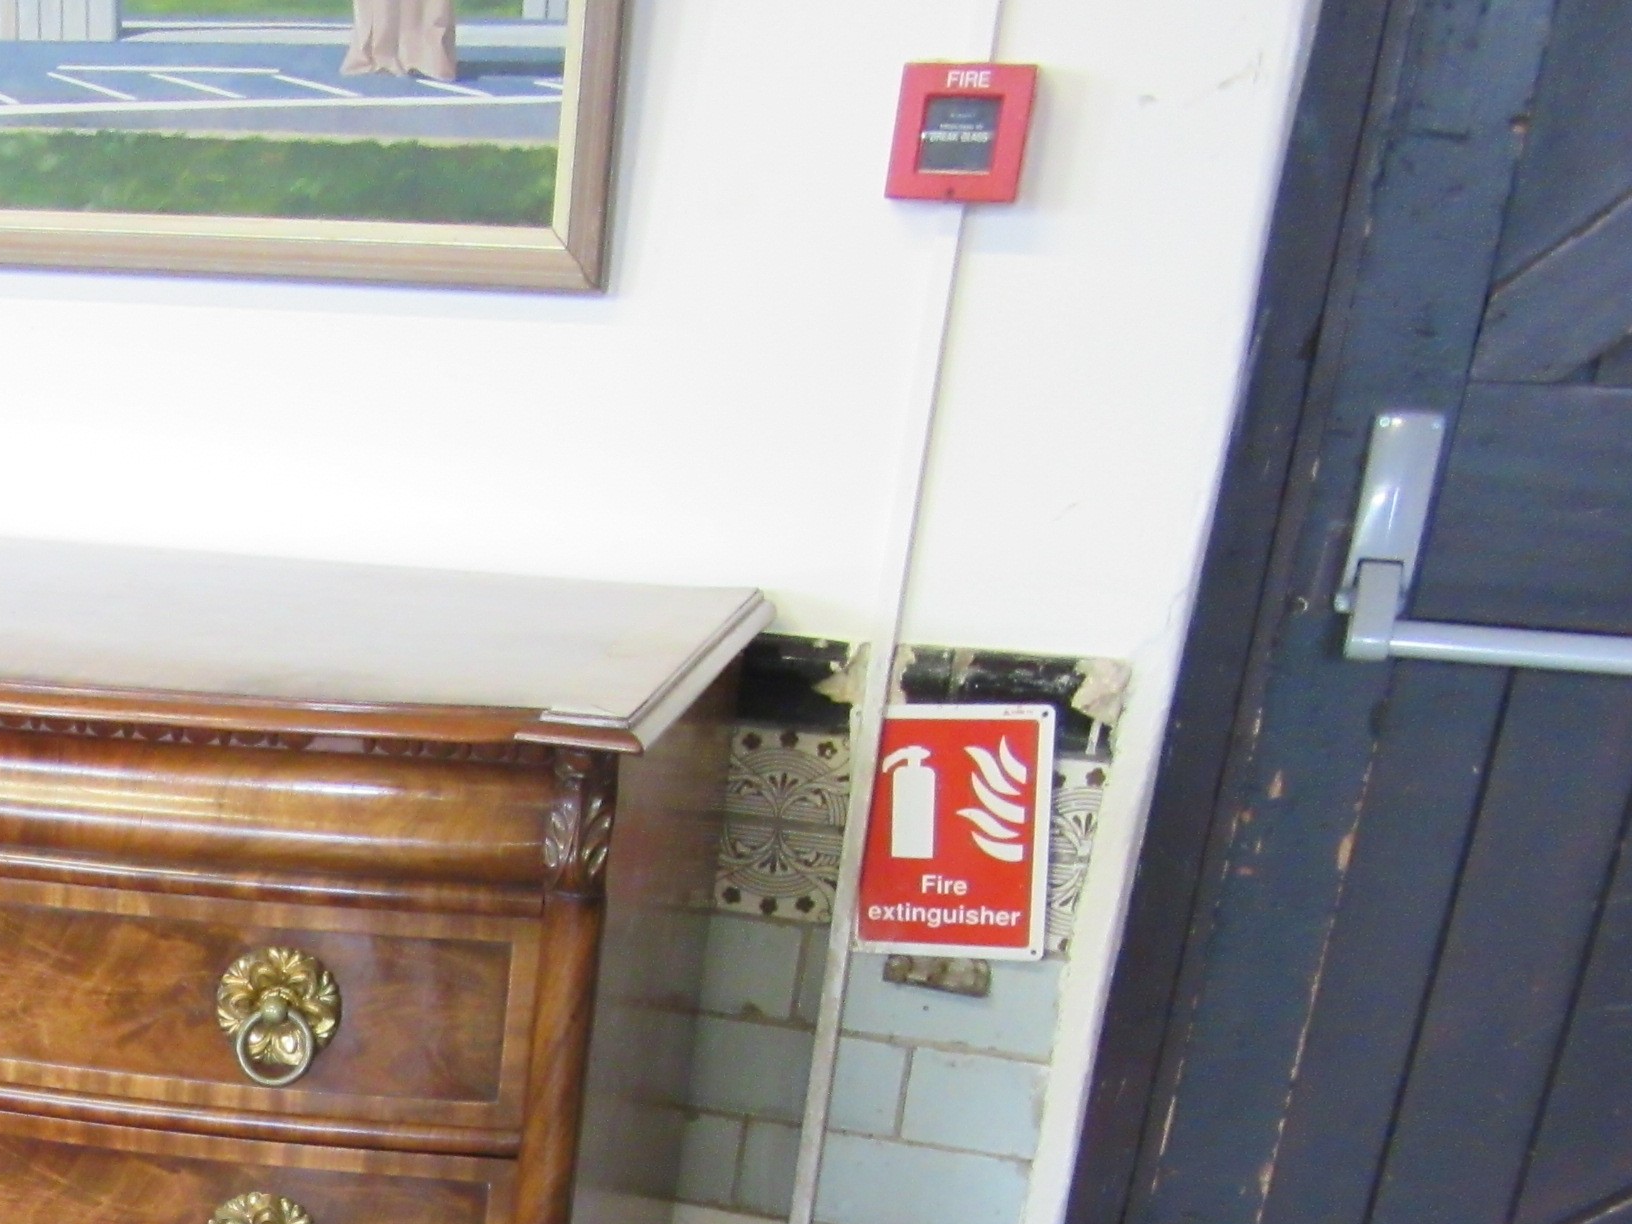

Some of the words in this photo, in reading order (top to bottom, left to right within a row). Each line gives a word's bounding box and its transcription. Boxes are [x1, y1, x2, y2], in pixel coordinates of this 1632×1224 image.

[946, 70, 992, 89] FIRE
[921, 873, 968, 896] Fire
[868, 902, 1021, 928] extinguisher
